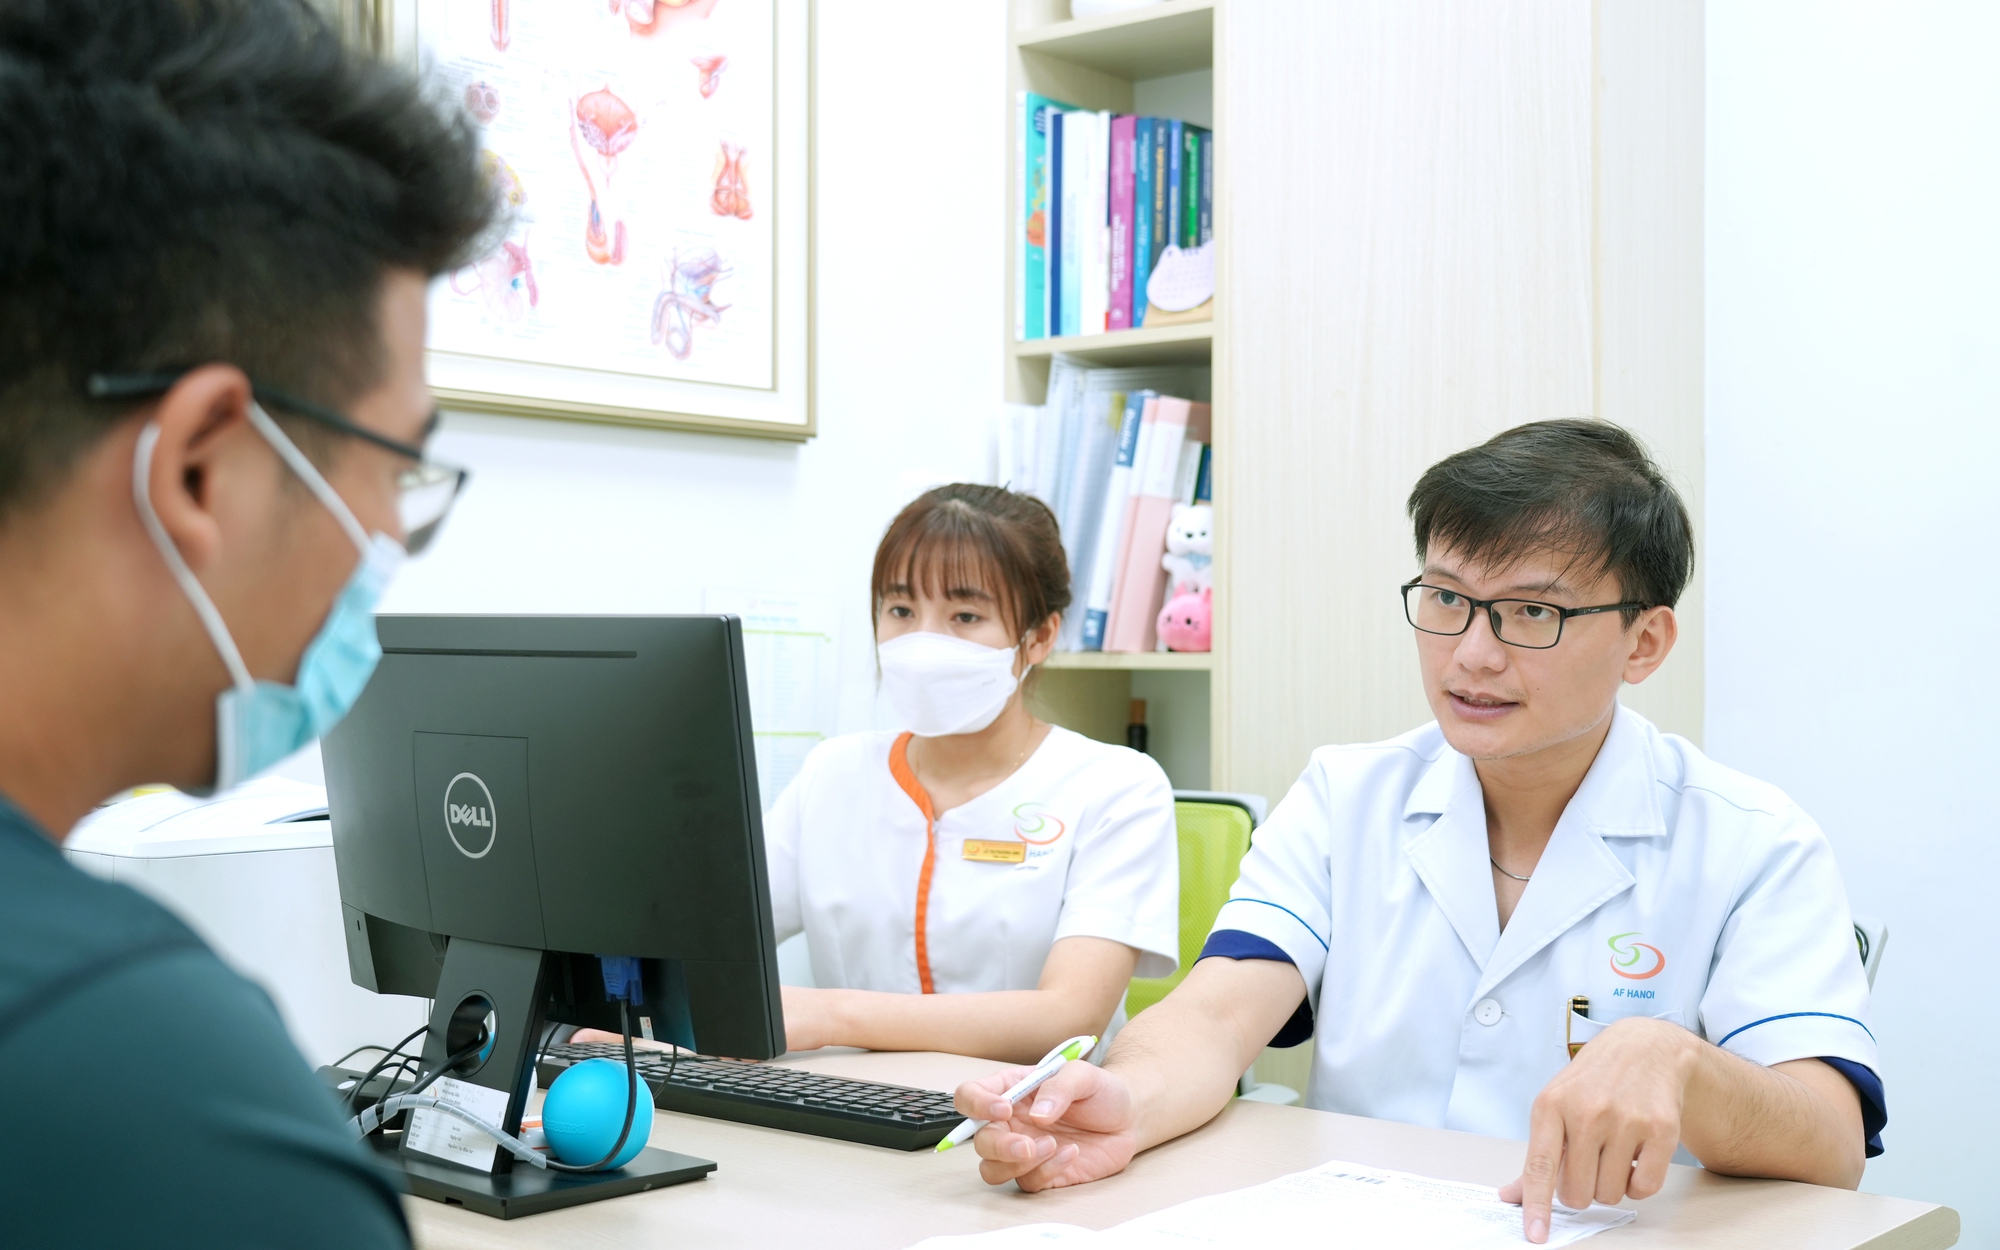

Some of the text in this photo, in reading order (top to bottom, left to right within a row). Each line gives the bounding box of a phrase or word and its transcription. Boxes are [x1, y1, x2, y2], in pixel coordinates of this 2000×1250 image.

[450, 803, 491, 827] DELL
[1613, 988, 1655, 999] AF HANOI
